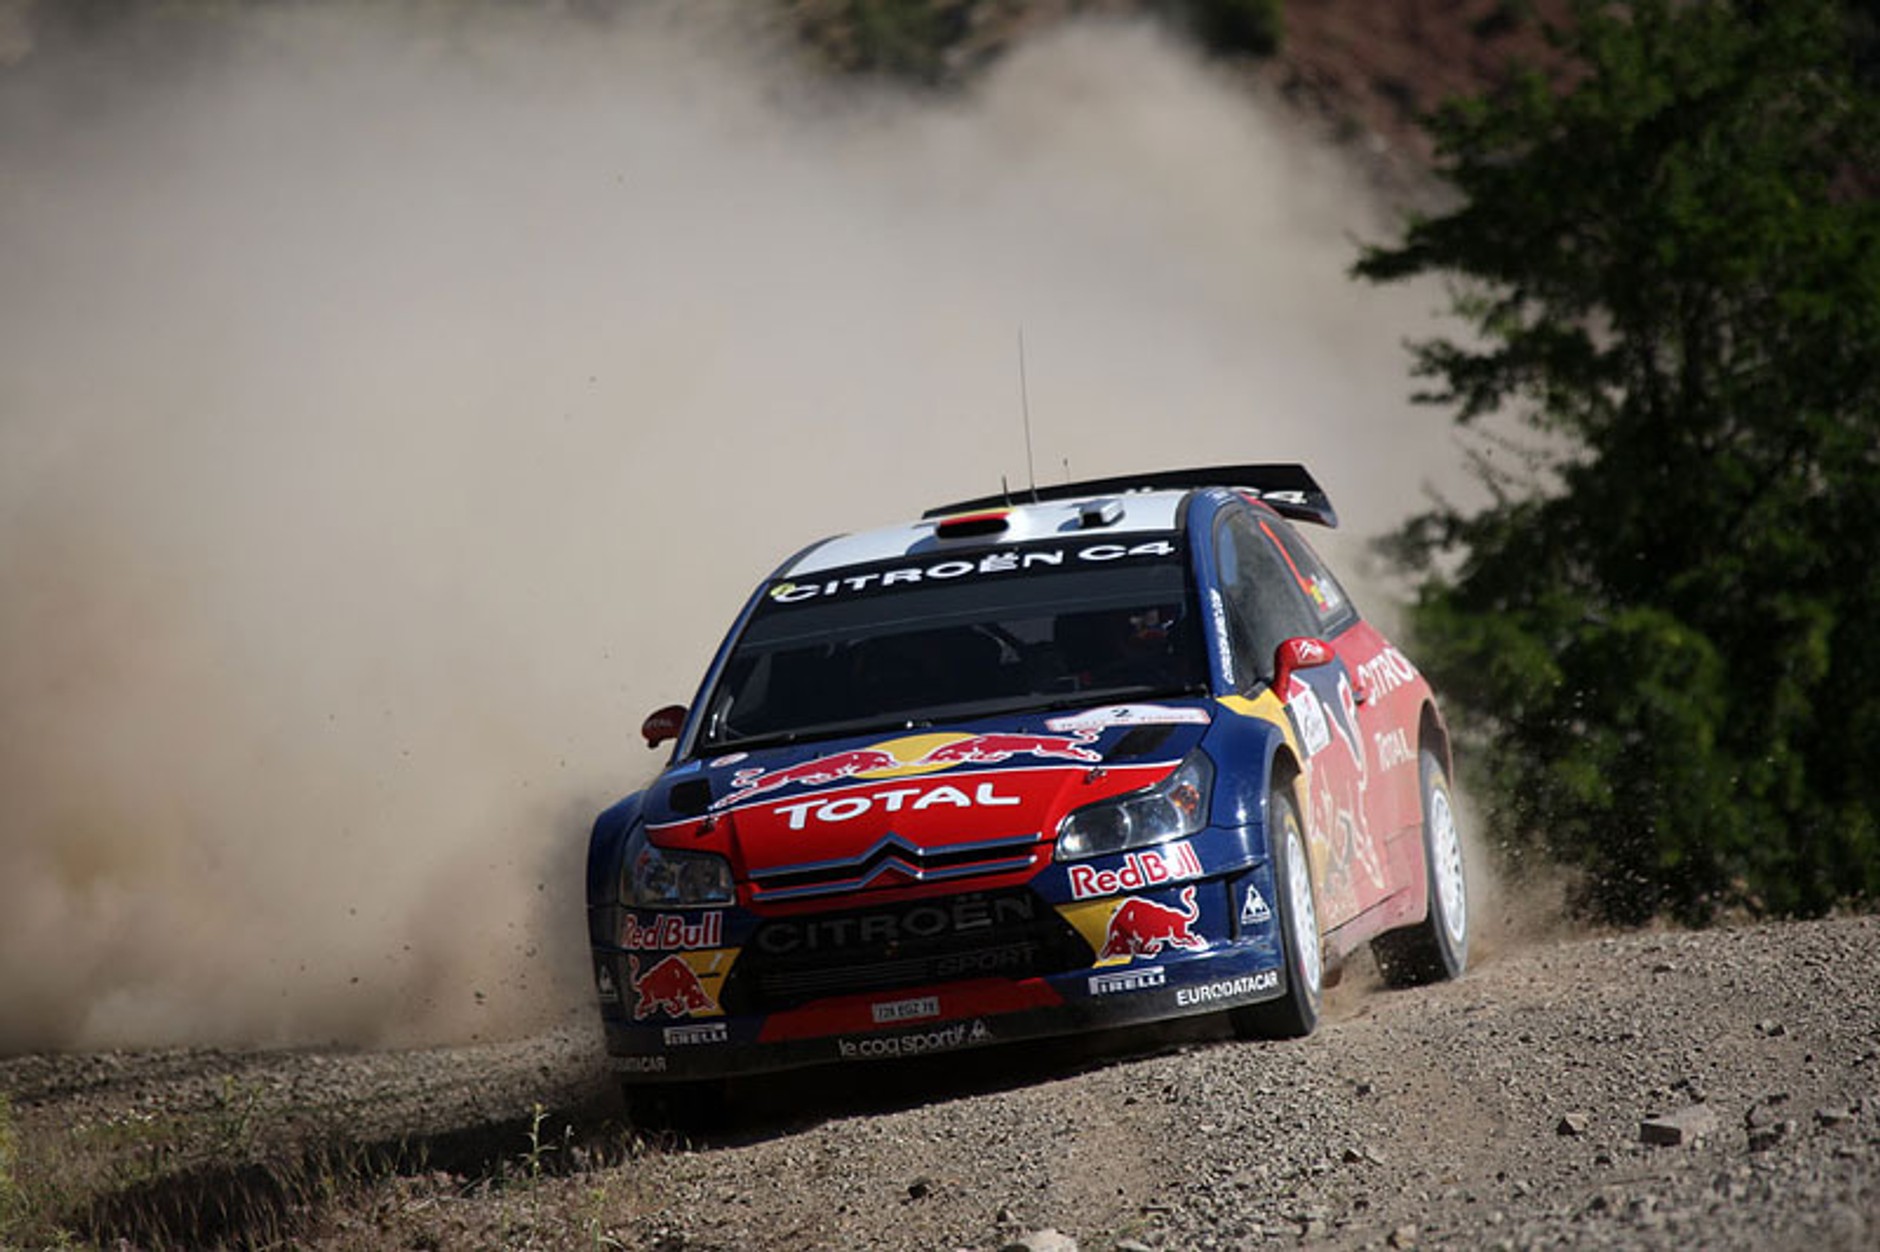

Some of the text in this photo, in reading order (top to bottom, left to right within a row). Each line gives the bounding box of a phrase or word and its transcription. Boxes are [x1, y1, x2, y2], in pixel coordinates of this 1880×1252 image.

[773, 547, 1063, 602] CITROËN
[1077, 540, 1176, 562] C4
[1357, 648, 1419, 706] CITRO
[773, 782, 1021, 831] TOTAL
[1067, 840, 1204, 900] Red Bull
[620, 910, 723, 949] Red Bull
[757, 892, 1035, 954] CITROËN
[936, 946, 1036, 977] SPORT
[1088, 965, 1167, 996] PIRELLI
[1176, 970, 1279, 1006] EURODATACAR
[663, 1022, 728, 1046] PIRELLI
[838, 1023, 966, 1058] le coq sportif
